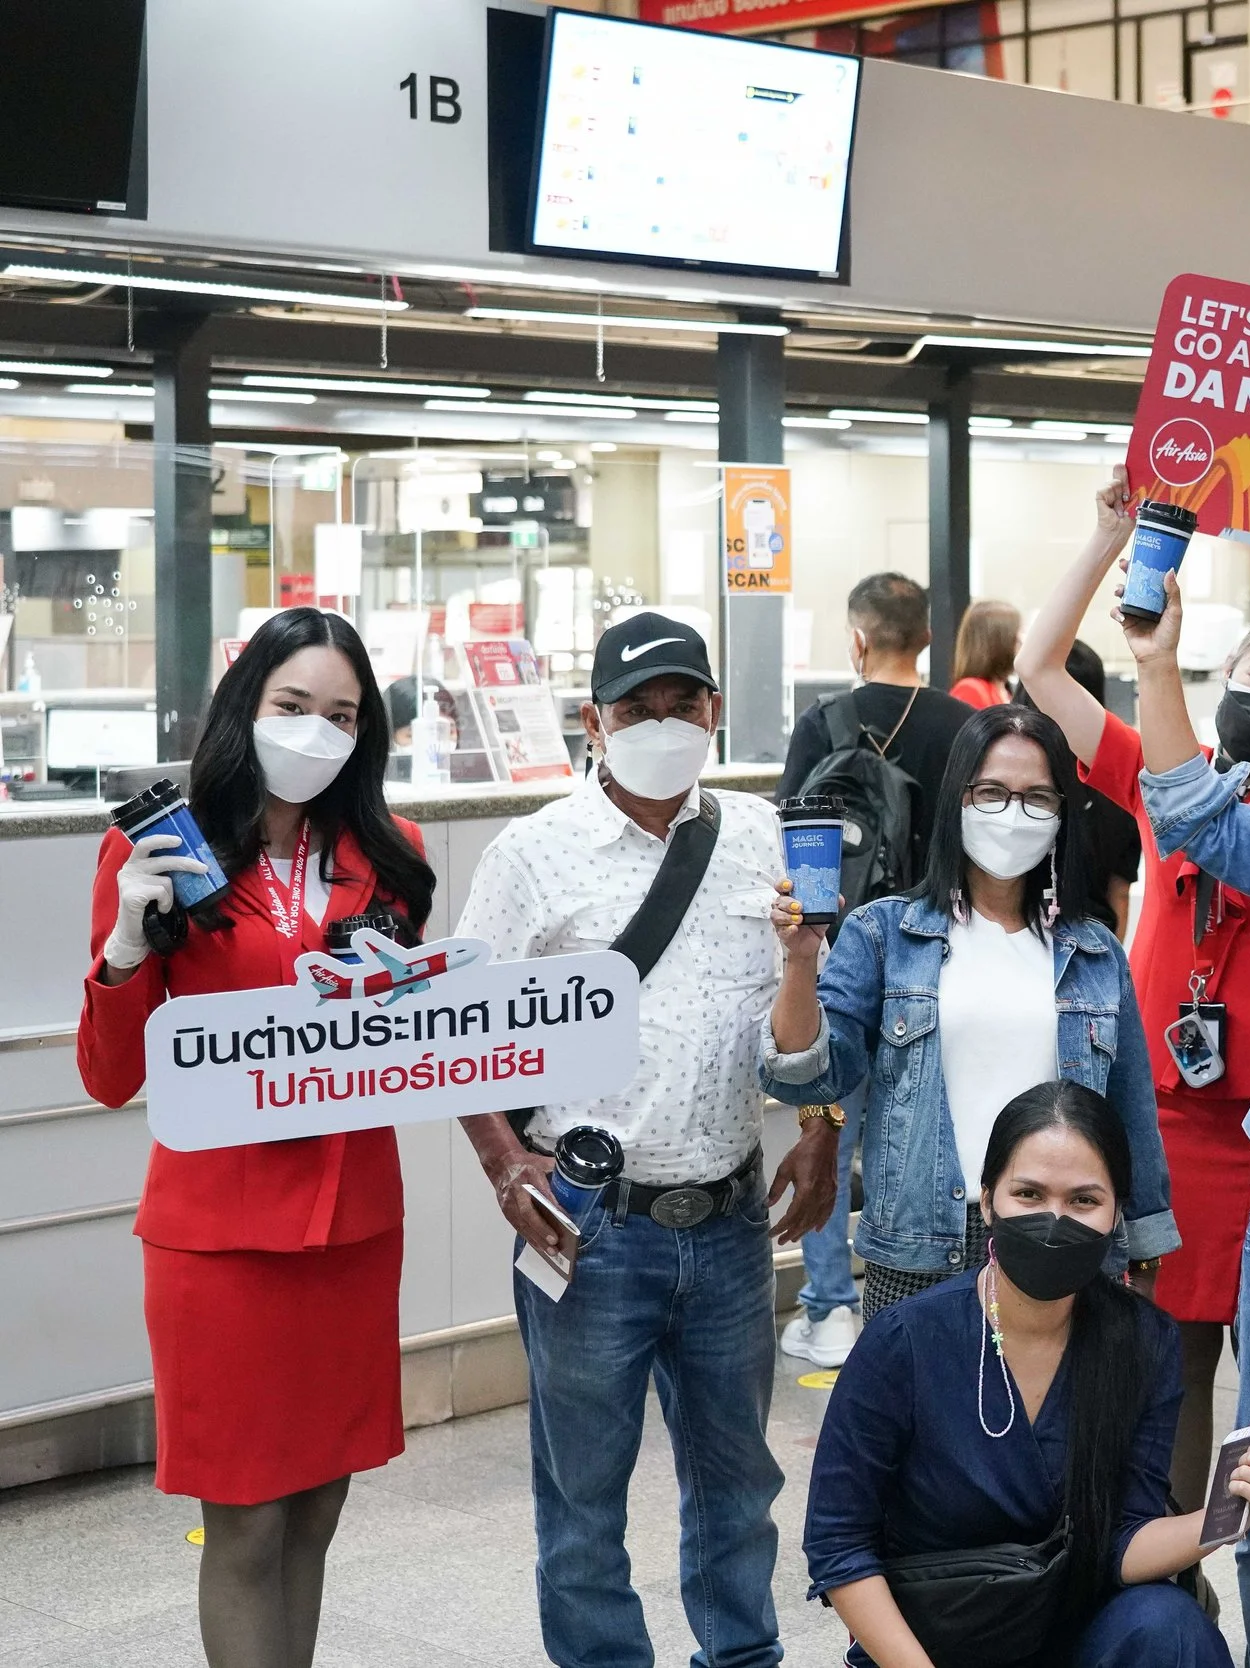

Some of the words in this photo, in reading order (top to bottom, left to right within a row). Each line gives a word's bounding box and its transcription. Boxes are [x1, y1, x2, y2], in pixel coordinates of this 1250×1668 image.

[399, 73, 462, 125] 1B
[1174, 327, 1223, 361] GO
[1163, 360, 1225, 409] DA
[1155, 437, 1209, 464] AirAsia
[1135, 533, 1162, 546] MAGIC
[791, 841, 825, 849] JOURNEYS
[792, 834, 824, 843] MAGIC
[297, 842, 306, 857] ALL
[295, 856, 305, 870] FOR
[262, 865, 274, 881] ALL
[293, 870, 303, 884] ONE
[291, 886, 302, 901] ONE
[289, 900, 300, 918] FOR
[311, 967, 339, 988] AirAsia
[172, 1000, 490, 1069] บินต่างประเทศ
[506, 974, 615, 1031] มั่นใจ
[247, 1042, 545, 1110] ไปกับแอร์เอเชีย
